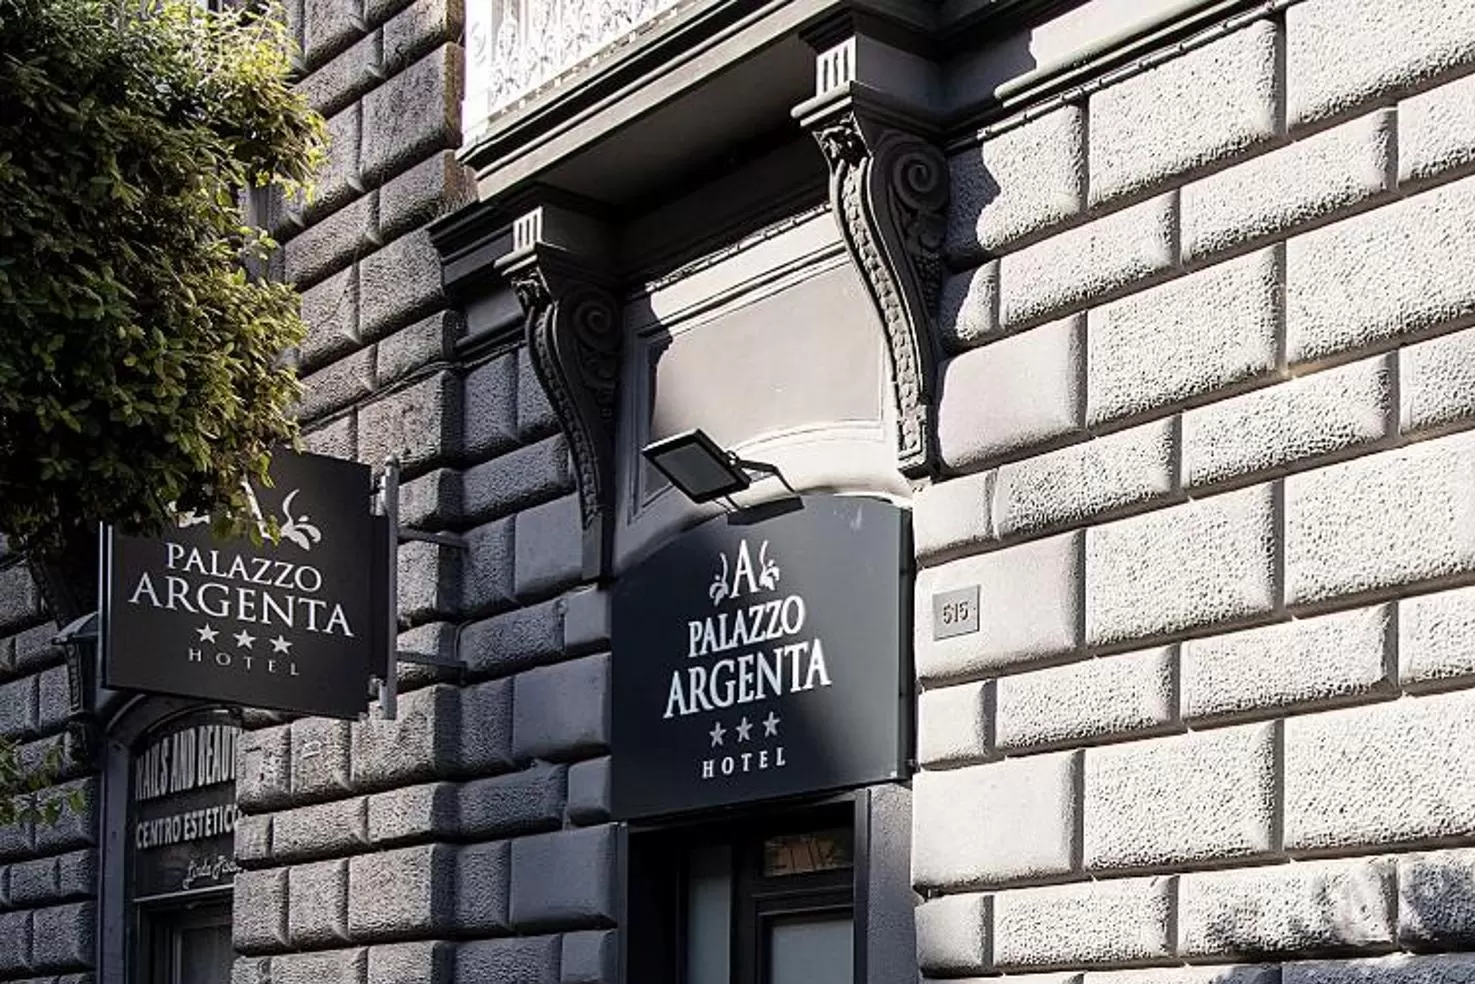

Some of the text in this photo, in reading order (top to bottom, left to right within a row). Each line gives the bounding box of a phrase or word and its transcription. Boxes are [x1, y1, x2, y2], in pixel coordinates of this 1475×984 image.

[165, 542, 323, 593] PALAZZO
[730, 538, 758, 598] A
[128, 572, 355, 637] ARGENTA
[687, 594, 806, 658] PALAZZO
[187, 648, 300, 677] HOTEL
[662, 637, 832, 719] ARGENTA
[170, 728, 196, 793] AND
[701, 747, 786, 779] HOTEL
[136, 814, 181, 850] CENTRO
